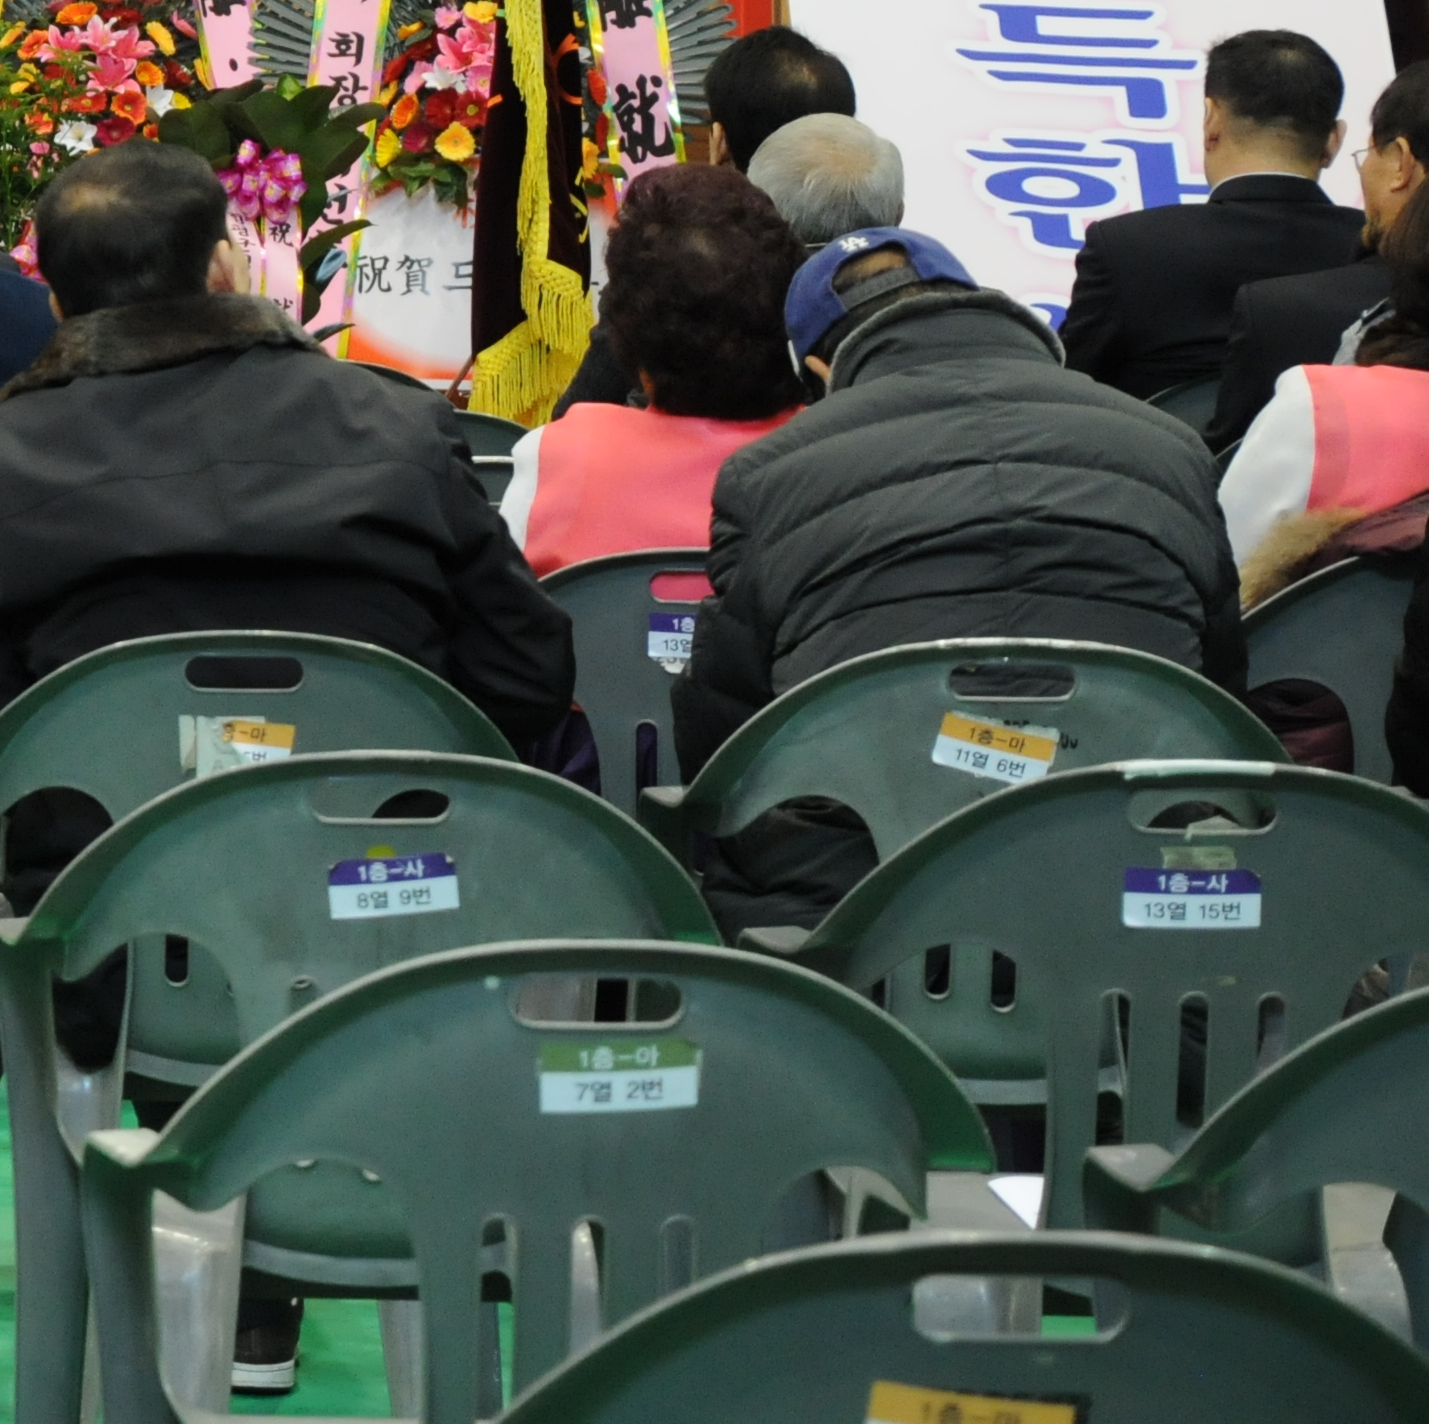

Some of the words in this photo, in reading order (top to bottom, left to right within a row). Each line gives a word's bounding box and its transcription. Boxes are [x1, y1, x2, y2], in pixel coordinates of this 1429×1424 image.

[671, 616, 696, 633] 1층
[969, 727, 1027, 753] 1층-마
[955, 747, 990, 770] 11열
[996, 758, 1027, 779] 6번
[357, 858, 425, 883] 1층-사
[1157, 872, 1229, 894] 1층-사
[357, 890, 389, 910] 8열
[399, 886, 432, 906] 9번
[1144, 902, 1187, 921] 13열
[1198, 902, 1242, 922] 15번
[574, 1080, 613, 1103] 7열
[626, 1077, 664, 1101] 2번
